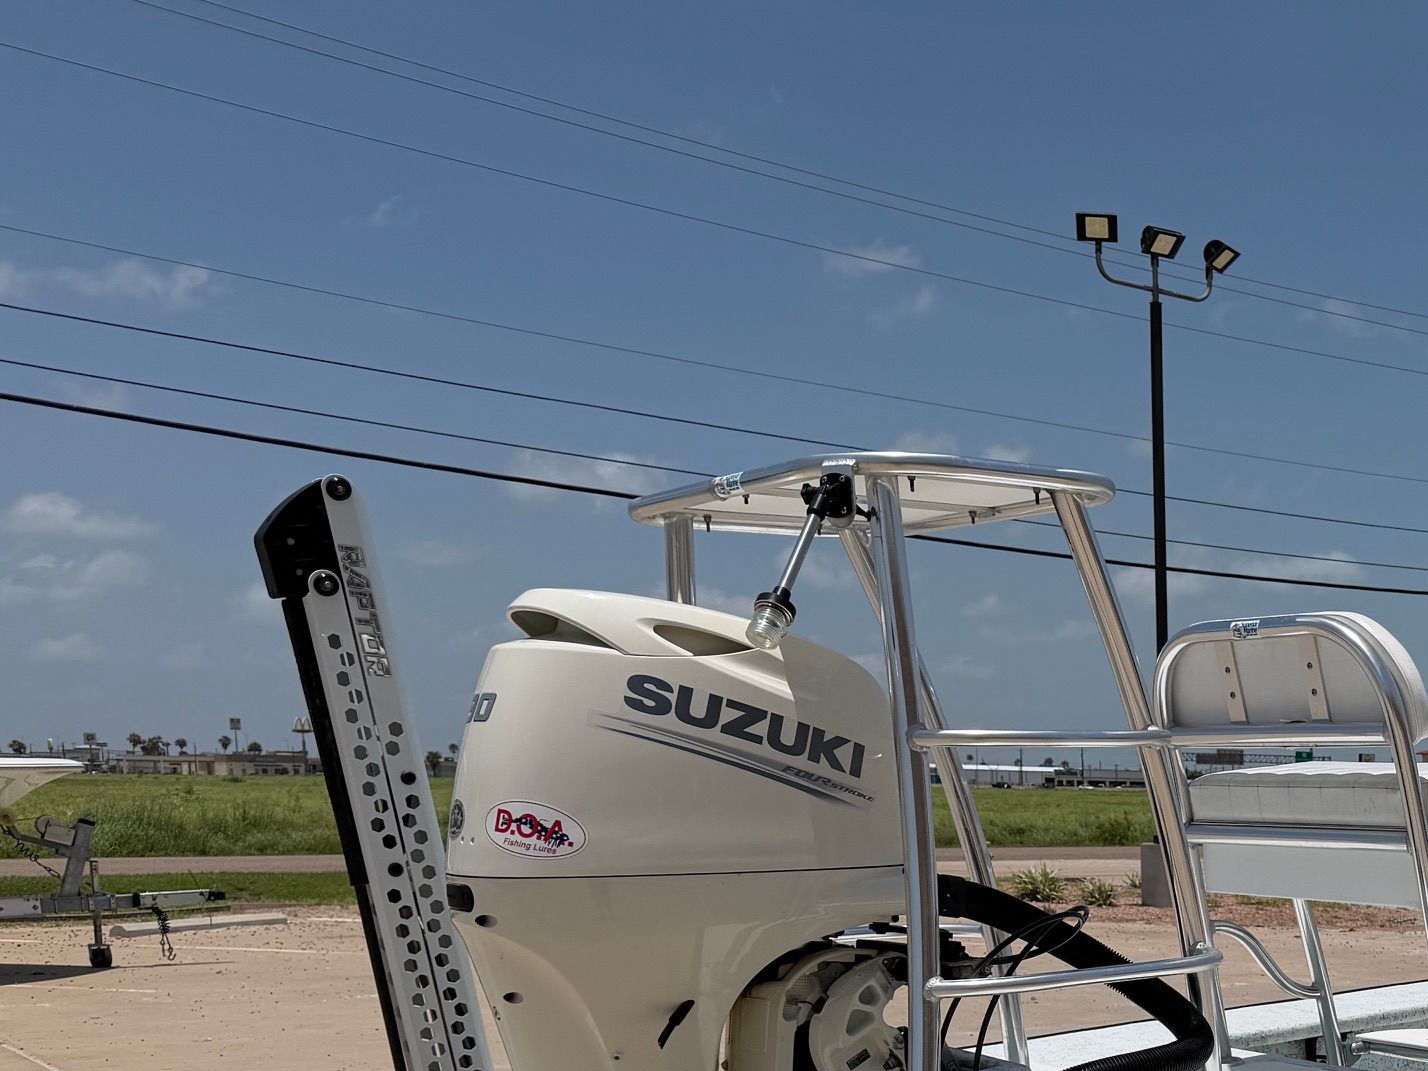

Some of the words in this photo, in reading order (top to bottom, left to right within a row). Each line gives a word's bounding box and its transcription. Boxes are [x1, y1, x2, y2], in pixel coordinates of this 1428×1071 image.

[338, 544, 392, 677] RAPTOR
[623, 674, 866, 778] SUZUKI
[503, 837, 532, 851] Fishing
[533, 843, 558, 855] Lures
